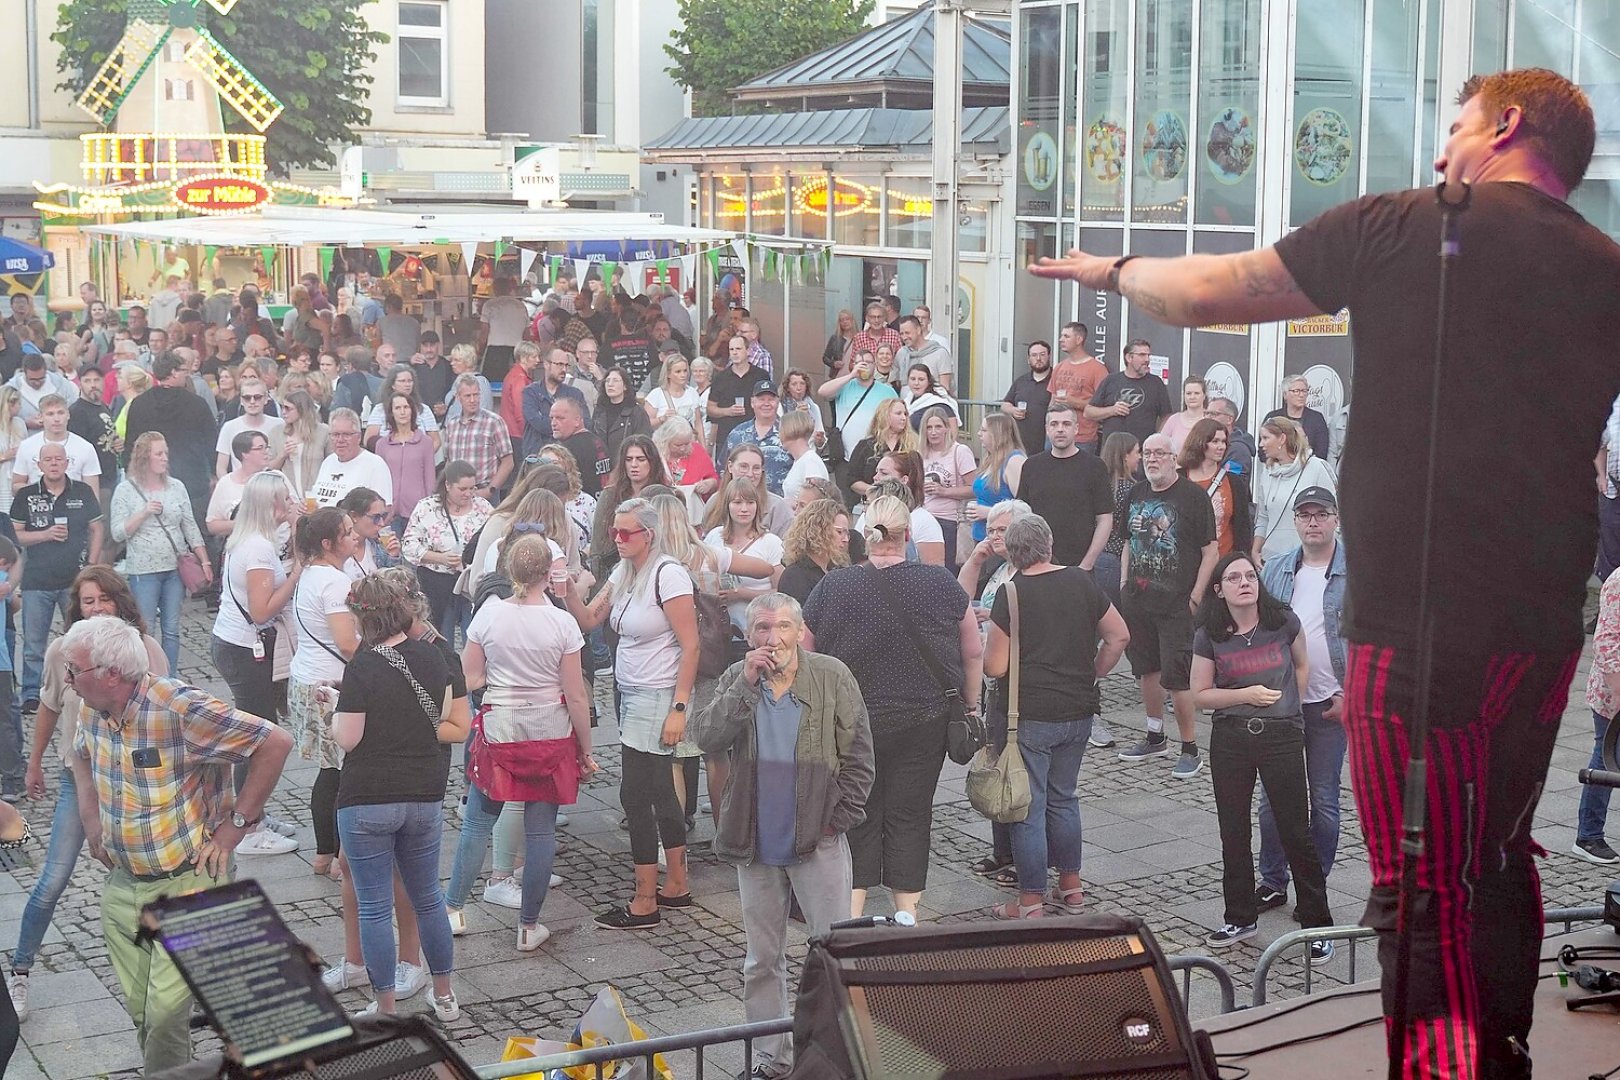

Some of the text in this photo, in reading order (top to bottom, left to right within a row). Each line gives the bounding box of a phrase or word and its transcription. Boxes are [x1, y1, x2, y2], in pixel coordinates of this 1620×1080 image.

[187, 185, 257, 203] zur Mühle
[1126, 1023, 1150, 1038] RCF
